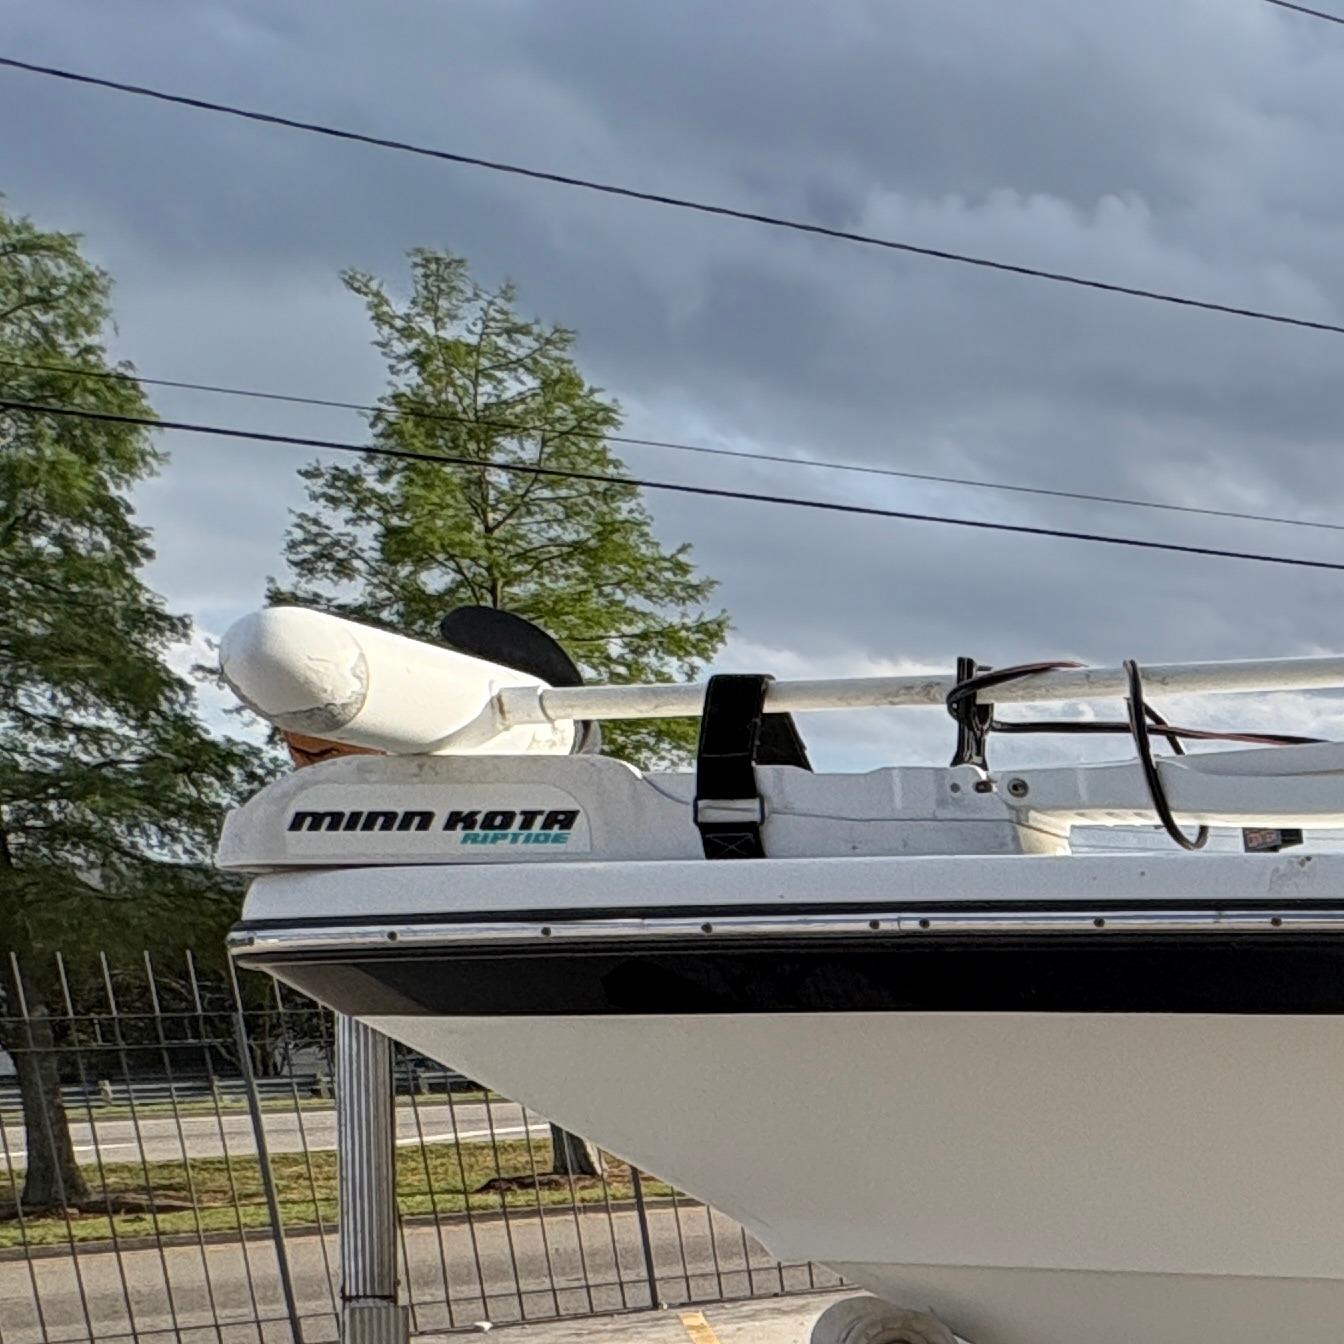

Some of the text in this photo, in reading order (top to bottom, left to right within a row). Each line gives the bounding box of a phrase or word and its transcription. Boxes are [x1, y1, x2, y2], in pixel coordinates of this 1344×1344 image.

[287, 809, 581, 832] MINN KOTA
[460, 832, 572, 845] RIPTIDE
